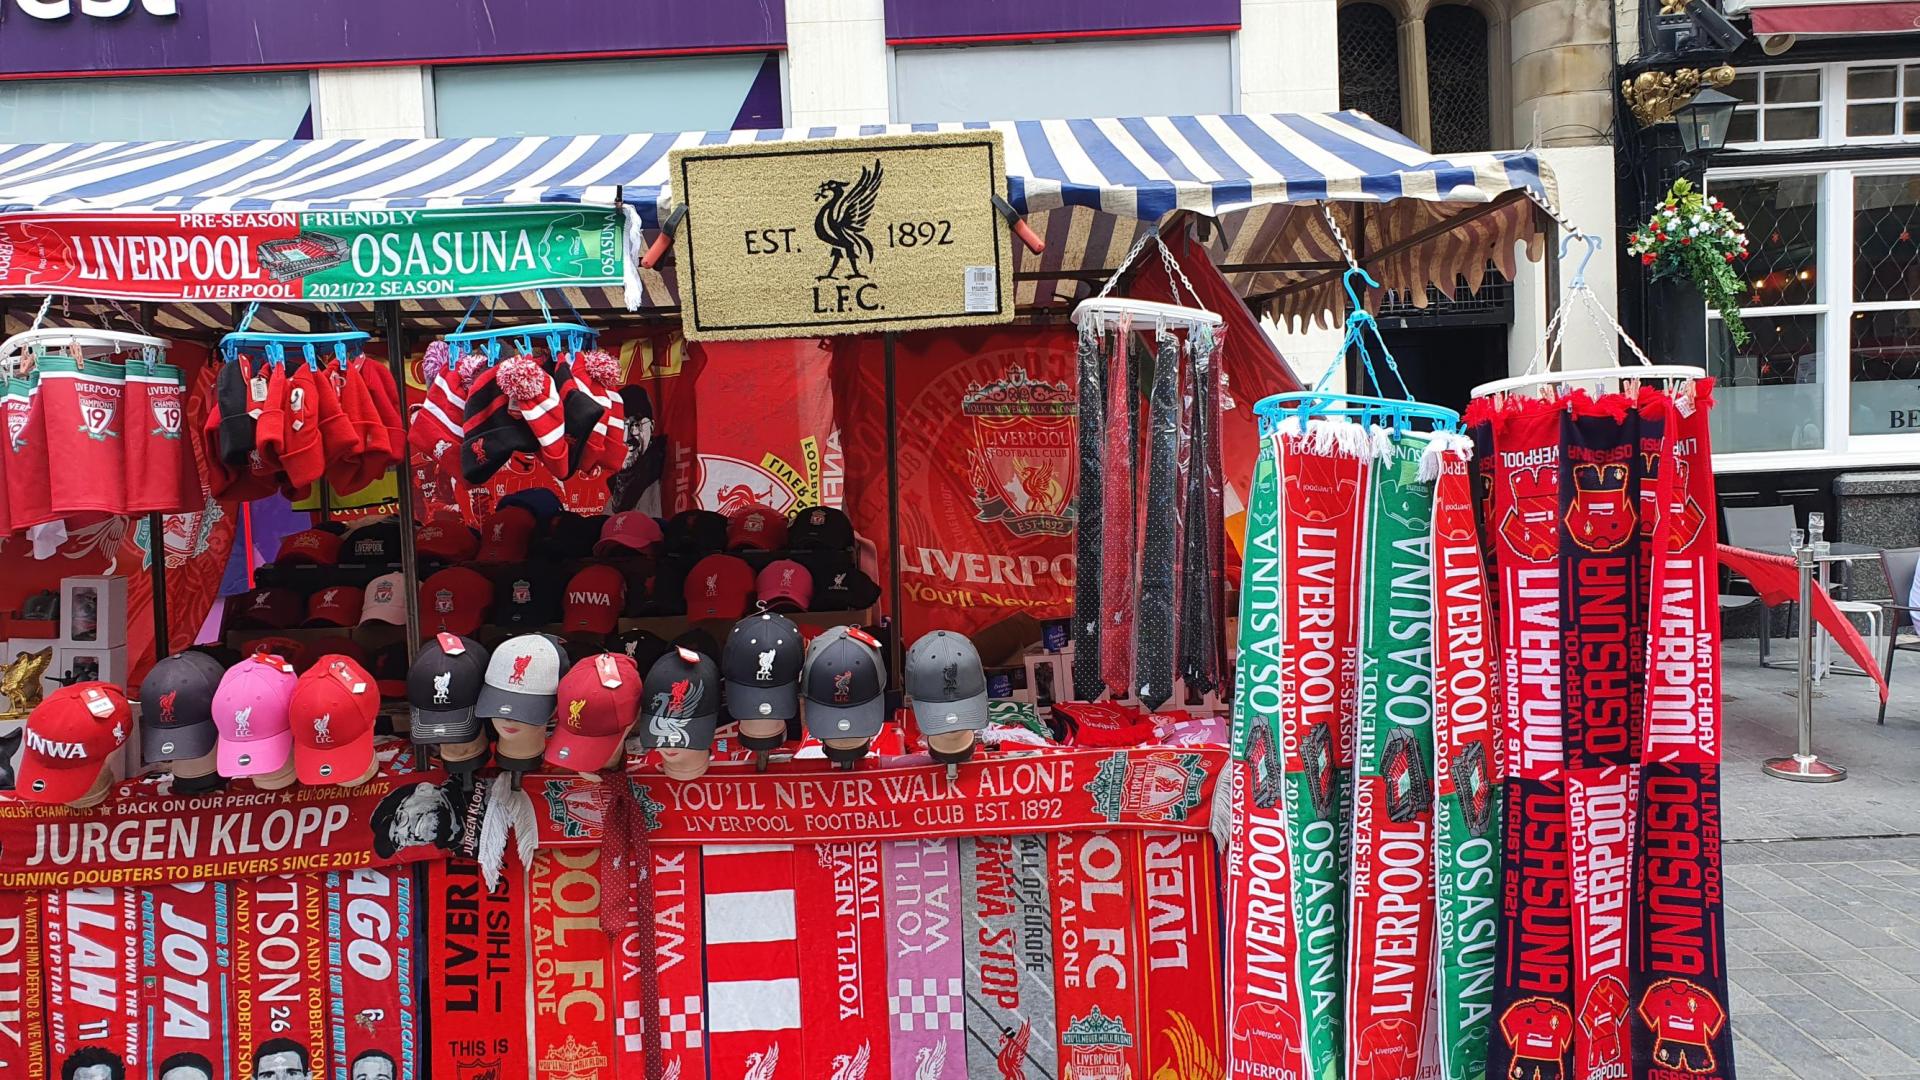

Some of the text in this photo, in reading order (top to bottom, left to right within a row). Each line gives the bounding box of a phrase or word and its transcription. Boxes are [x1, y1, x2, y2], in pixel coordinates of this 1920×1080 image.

[179, 212, 297, 228] PRE-SEASON
[302, 209, 417, 227] FRIENDLY
[601, 211, 617, 275] OSASUNA
[744, 219, 954, 255] EST. 1892
[70, 235, 262, 281] LIVERPOOL
[351, 228, 537, 278] OSASUNA
[182, 284, 296, 299] LIVERPOOL
[307, 280, 455, 298] 2021/22 SEASON
[812, 282, 885, 314] L.F.C.
[74, 382, 122, 398] LIVERPOOL
[86, 408, 107, 430] 19
[164, 408, 181, 429] 19
[985, 431, 1070, 447] LIVERPOOL
[991, 448, 1068, 458] FOOTBALL CLUB
[569, 591, 611, 607] YNWA
[1250, 526, 1280, 714] OSASUNA
[1297, 525, 1338, 726] LIVERPOOL
[1384, 535, 1432, 726] OSASUNA
[1443, 543, 1488, 747] LIVERPOOL
[1578, 556, 1628, 755] OSASUNA
[1629, 625, 1642, 674] 2021
[1233, 643, 1247, 757] FRIENDLY
[1281, 643, 1298, 764] LIVERPOOL
[1340, 646, 1356, 764] PRE-SEASON
[1360, 652, 1379, 772] FRIENDLY
[1505, 648, 1521, 778] MONDAY 9TH
[1565, 624, 1583, 742] LIVERPOOL
[1696, 632, 1715, 756] MATCHDAY
[26, 727, 88, 760] YNWA
[1435, 665, 1451, 788] LIVERPOOL
[1488, 660, 1505, 780] PRE-SEASON
[1630, 682, 1643, 757] AUGUST
[296, 781, 390, 802] EUROPEAN GIANTS
[665, 759, 1074, 811] YOU'LL NEVER WALK ALONE
[1128, 761, 1147, 809] LIVERPOOL
[1568, 748, 1584, 770] IN
[26, 804, 350, 867] JURGEN KLOPP
[34, 805, 94, 818] CHAMPIONS
[117, 792, 276, 816] BACK ON OUR PERCH
[463, 780, 487, 857] JURGEN KLOPP
[683, 798, 1063, 833] LIVERPOOL FOOTBALL CLUB EST. 1892
[1231, 761, 1245, 877] PRE-SEASON
[1286, 778, 1300, 848] 2021/22
[1701, 762, 1721, 909] IN LIVERPOOL
[0, 850, 371, 887] TURNING DOUBTERS TO BELIEVERS SINCE 2015
[1020, 838, 1039, 872] ALL
[1354, 778, 1375, 898] PRE-SEASON
[1504, 782, 1522, 918] AUGUST 2021
[1568, 776, 1588, 904] MATCHDAY
[923, 836, 950, 955] WALK
[1245, 807, 1288, 1004] LIVERPOOL
[1438, 801, 1455, 950] 2021/22 SEASON
[1586, 773, 1628, 976] LIVERPOOL
[1646, 776, 1706, 976] OSASUNA
[25, 907, 38, 945] WATCH
[142, 890, 156, 967] PORTUGAL
[214, 881, 229, 968] NUMBER 20
[236, 887, 251, 985] ANDY ANDY
[305, 884, 320, 932] ANDY
[655, 851, 686, 974] WALK
[1024, 902, 1045, 973] EUROPE
[1302, 820, 1338, 1020] OSASUNA
[1370, 820, 1426, 1016] LIVERPOOL
[1456, 837, 1497, 1030] OSASUNA
[26, 947, 39, 967] HIM
[49, 922, 63, 1005] EGYPTIAN
[160, 902, 211, 1040] JOTA
[307, 936, 320, 984] ANDY
[329, 942, 342, 965] TIME
[486, 910, 510, 980] THIS
[533, 924, 557, 1016] ALONE
[837, 925, 861, 1021] YOU'LL
[978, 927, 1020, 1011] STOP
[1059, 896, 1080, 989] ALONE
[1082, 927, 1127, 990] FC
[26, 968, 40, 1009] DEFEND
[125, 936, 138, 1066] DOWN THE WING
[398, 947, 412, 1006] THIAGO
[554, 958, 606, 1025] FC
[27, 1021, 41, 1039] WE
[52, 1012, 66, 1054] KING
[79, 1019, 109, 1040] 11
[271, 1005, 291, 1033] 26
[448, 1038, 509, 1057] THIS IS
[1252, 1027, 1283, 1041] Liverpool
[1374, 1045, 1404, 1056] Liverpool
[28, 1040, 43, 1078] WATCH
[1076, 1052, 1120, 1066] LIVERPOOL
